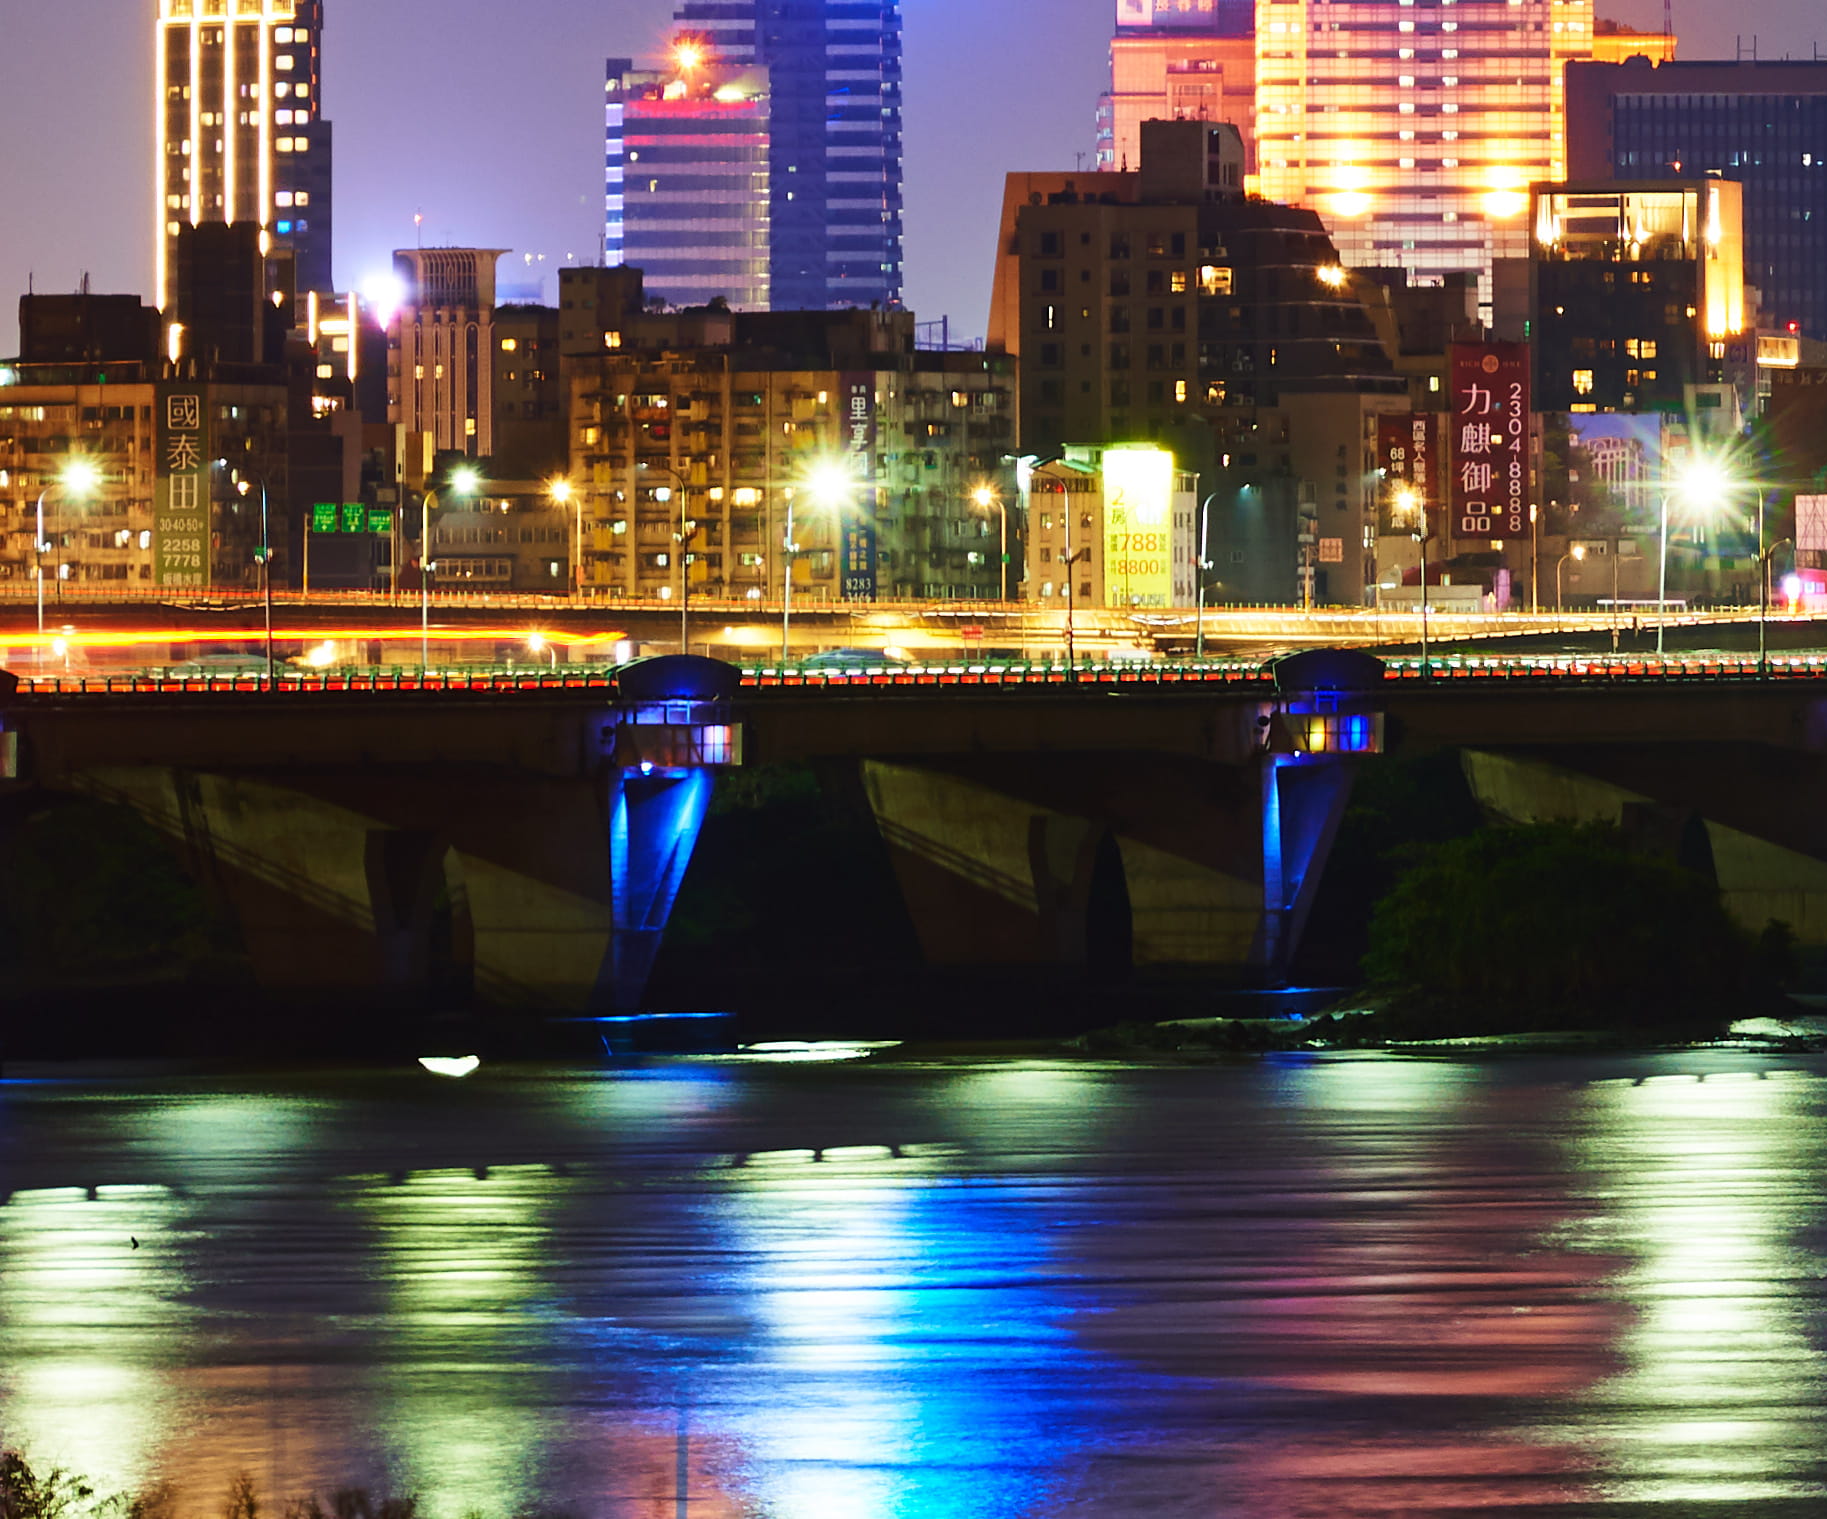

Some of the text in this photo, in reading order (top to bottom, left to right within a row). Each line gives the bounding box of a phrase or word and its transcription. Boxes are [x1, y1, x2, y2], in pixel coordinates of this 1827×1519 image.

[167, 395, 200, 510] 國泰田
[1461, 383, 1492, 531] 力麒御品
[1508, 382, 1522, 531] 2304-8888
[163, 539, 200, 552] 2258
[163, 555, 200, 567] 7778
[846, 578, 871, 591] 8283
